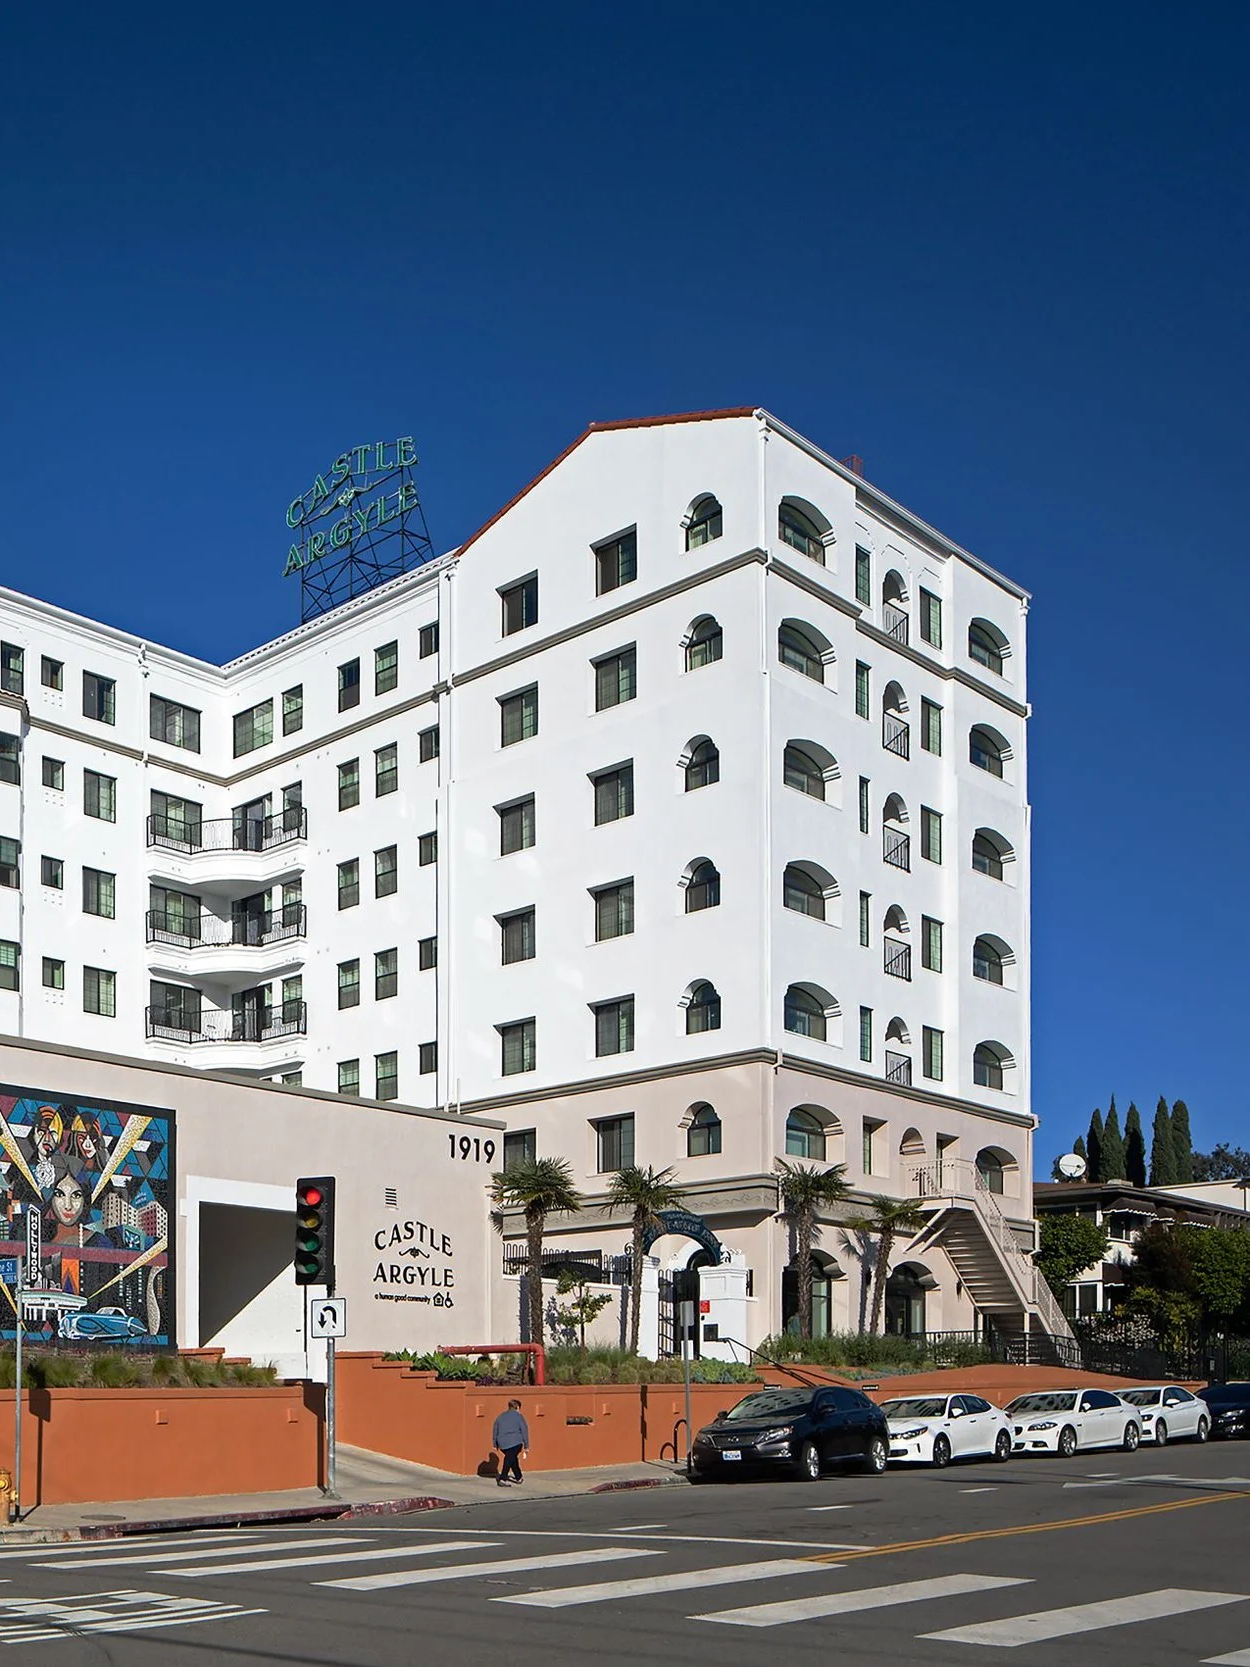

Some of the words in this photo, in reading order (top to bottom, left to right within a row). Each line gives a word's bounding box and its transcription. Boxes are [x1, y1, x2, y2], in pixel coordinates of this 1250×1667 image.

[286, 436, 418, 529] CASTLE
[283, 480, 419, 577] ARGYLE
[448, 1134, 496, 1164] 1919
[30, 1214, 38, 1280] HOLLYWOOD
[374, 1221, 453, 1257] CASTLE
[373, 1262, 455, 1288] ARGYLE
